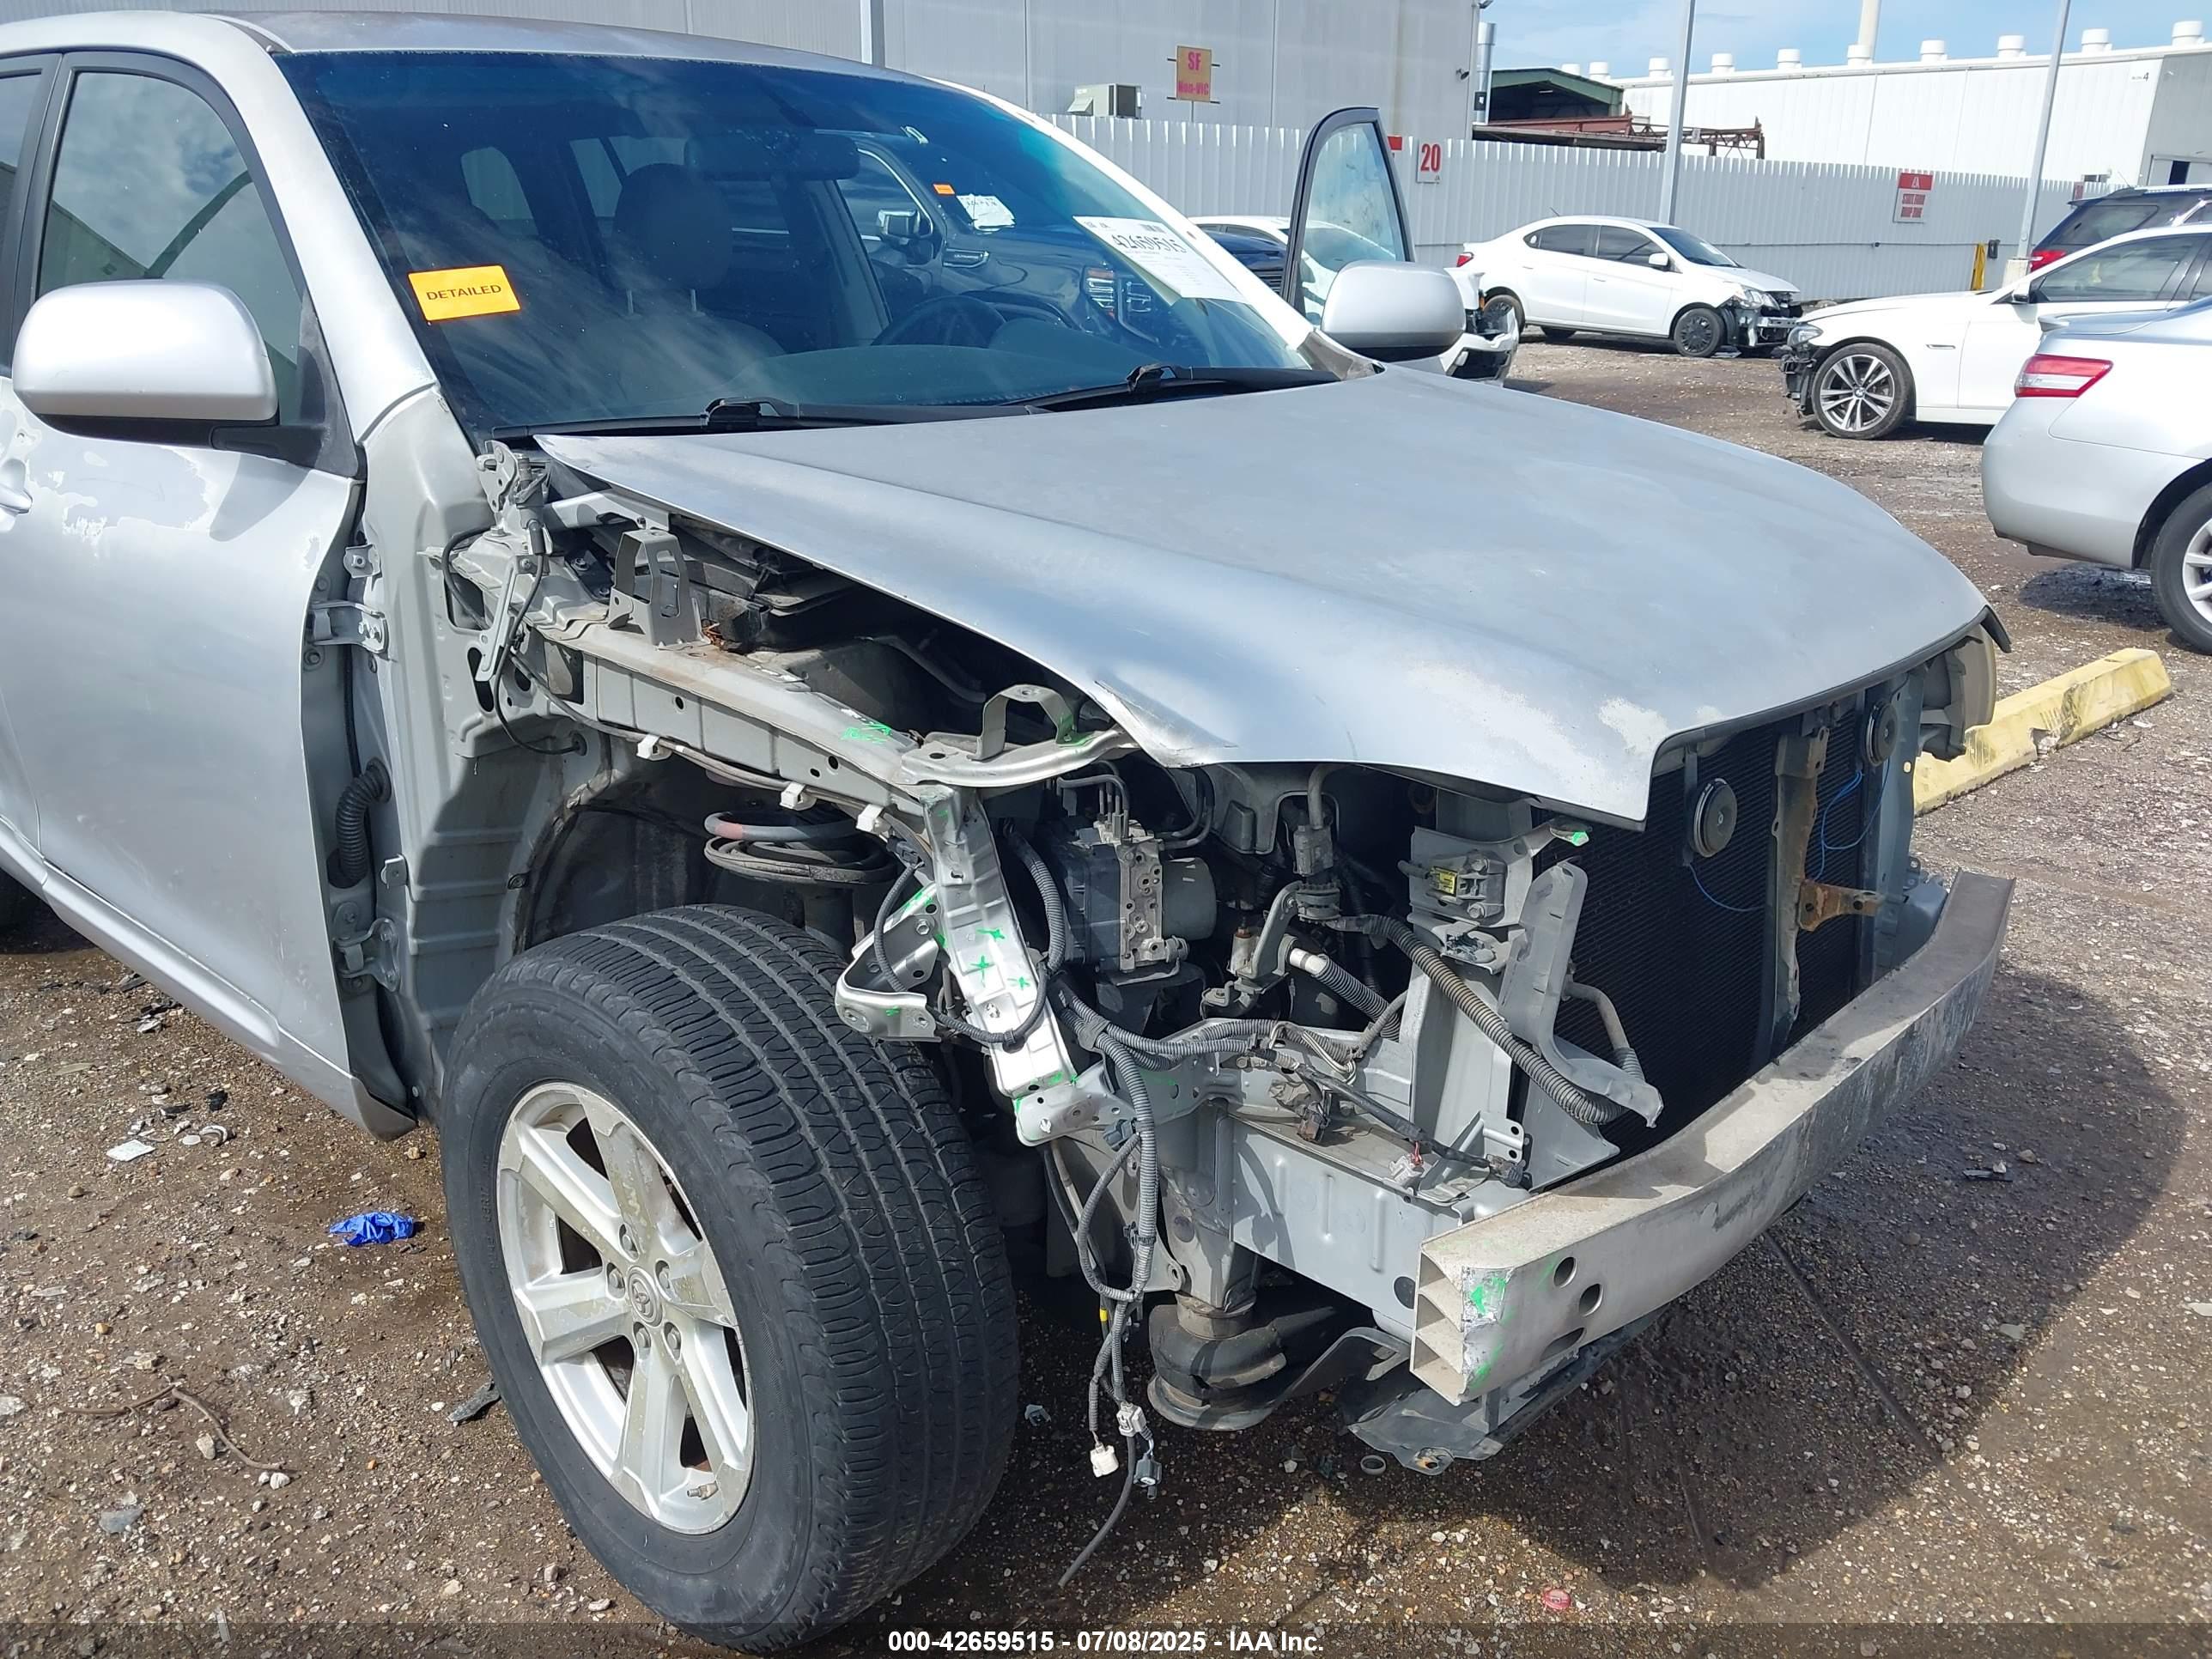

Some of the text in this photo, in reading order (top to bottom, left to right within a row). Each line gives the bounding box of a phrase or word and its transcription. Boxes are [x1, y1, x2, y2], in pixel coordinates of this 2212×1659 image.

[1188, 52, 1202, 70] SF
[1420, 143, 1441, 172] 20
[1111, 234, 1188, 253] 42659515
[426, 284, 501, 301] DETAILED
